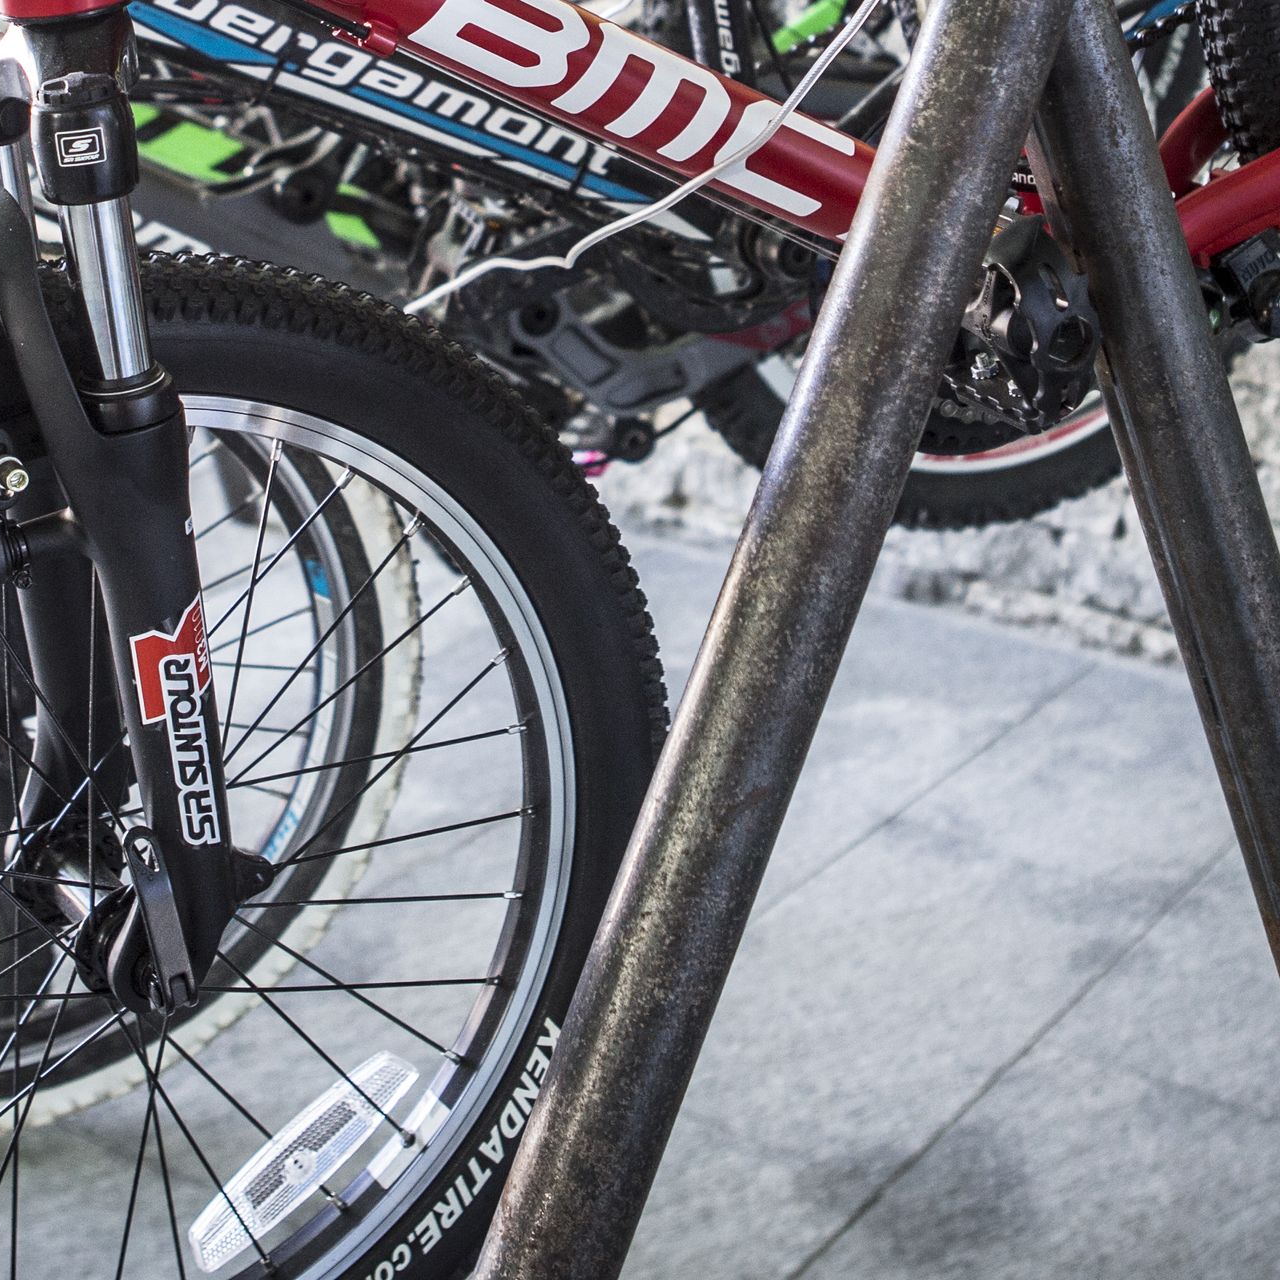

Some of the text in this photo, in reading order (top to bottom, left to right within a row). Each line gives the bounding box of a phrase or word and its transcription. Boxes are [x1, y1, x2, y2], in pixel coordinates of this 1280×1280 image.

[163, 658, 217, 843] SR SUNTOUR
[367, 1016, 563, 1280] KENDATIRE.CO
